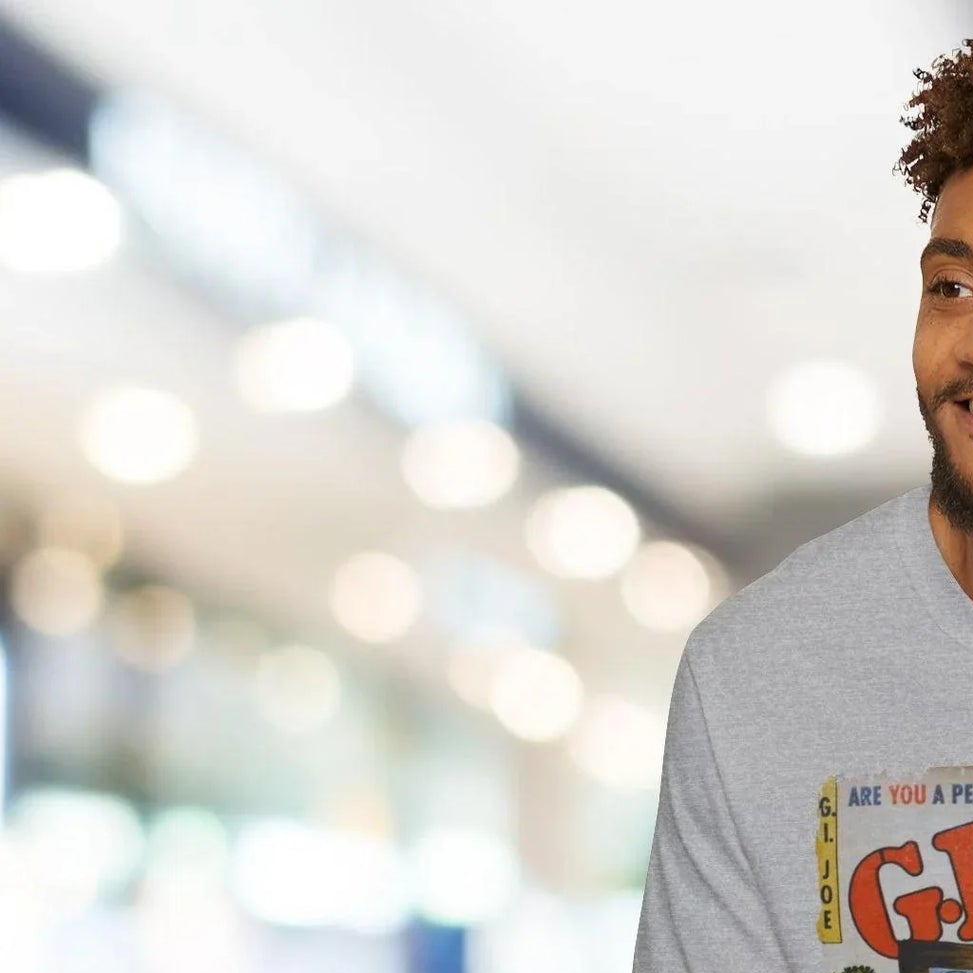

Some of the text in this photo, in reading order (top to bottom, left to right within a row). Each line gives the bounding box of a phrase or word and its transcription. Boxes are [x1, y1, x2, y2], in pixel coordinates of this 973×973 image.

[848, 785, 882, 807] ARE
[889, 784, 926, 806] YOU
[932, 785, 945, 804] A
